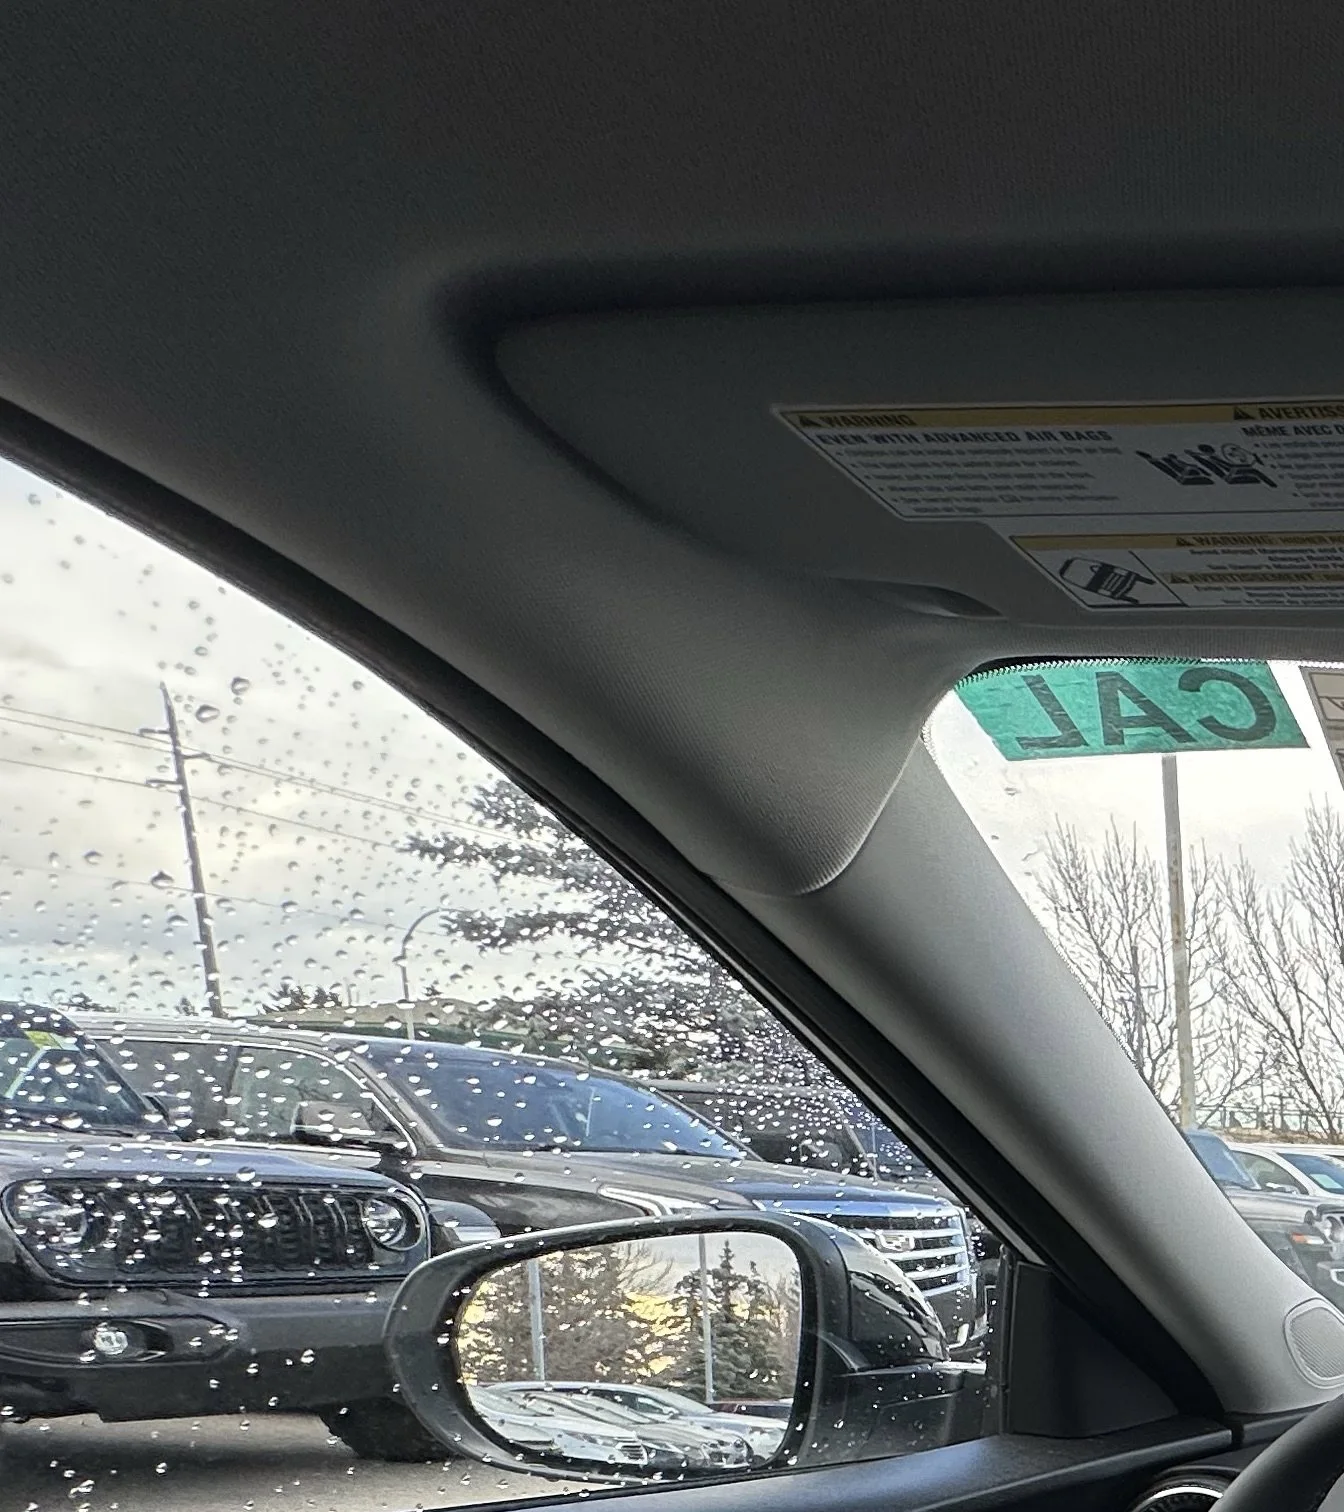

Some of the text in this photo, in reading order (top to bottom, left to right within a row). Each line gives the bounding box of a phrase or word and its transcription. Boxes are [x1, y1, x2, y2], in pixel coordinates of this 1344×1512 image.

[818, 414, 918, 427] WARNING
[1241, 424, 1291, 436] MÊME
[1292, 424, 1334, 436] AVEC
[815, 430, 1113, 445] EVEN WITH ADVANCED AIR BAGS
